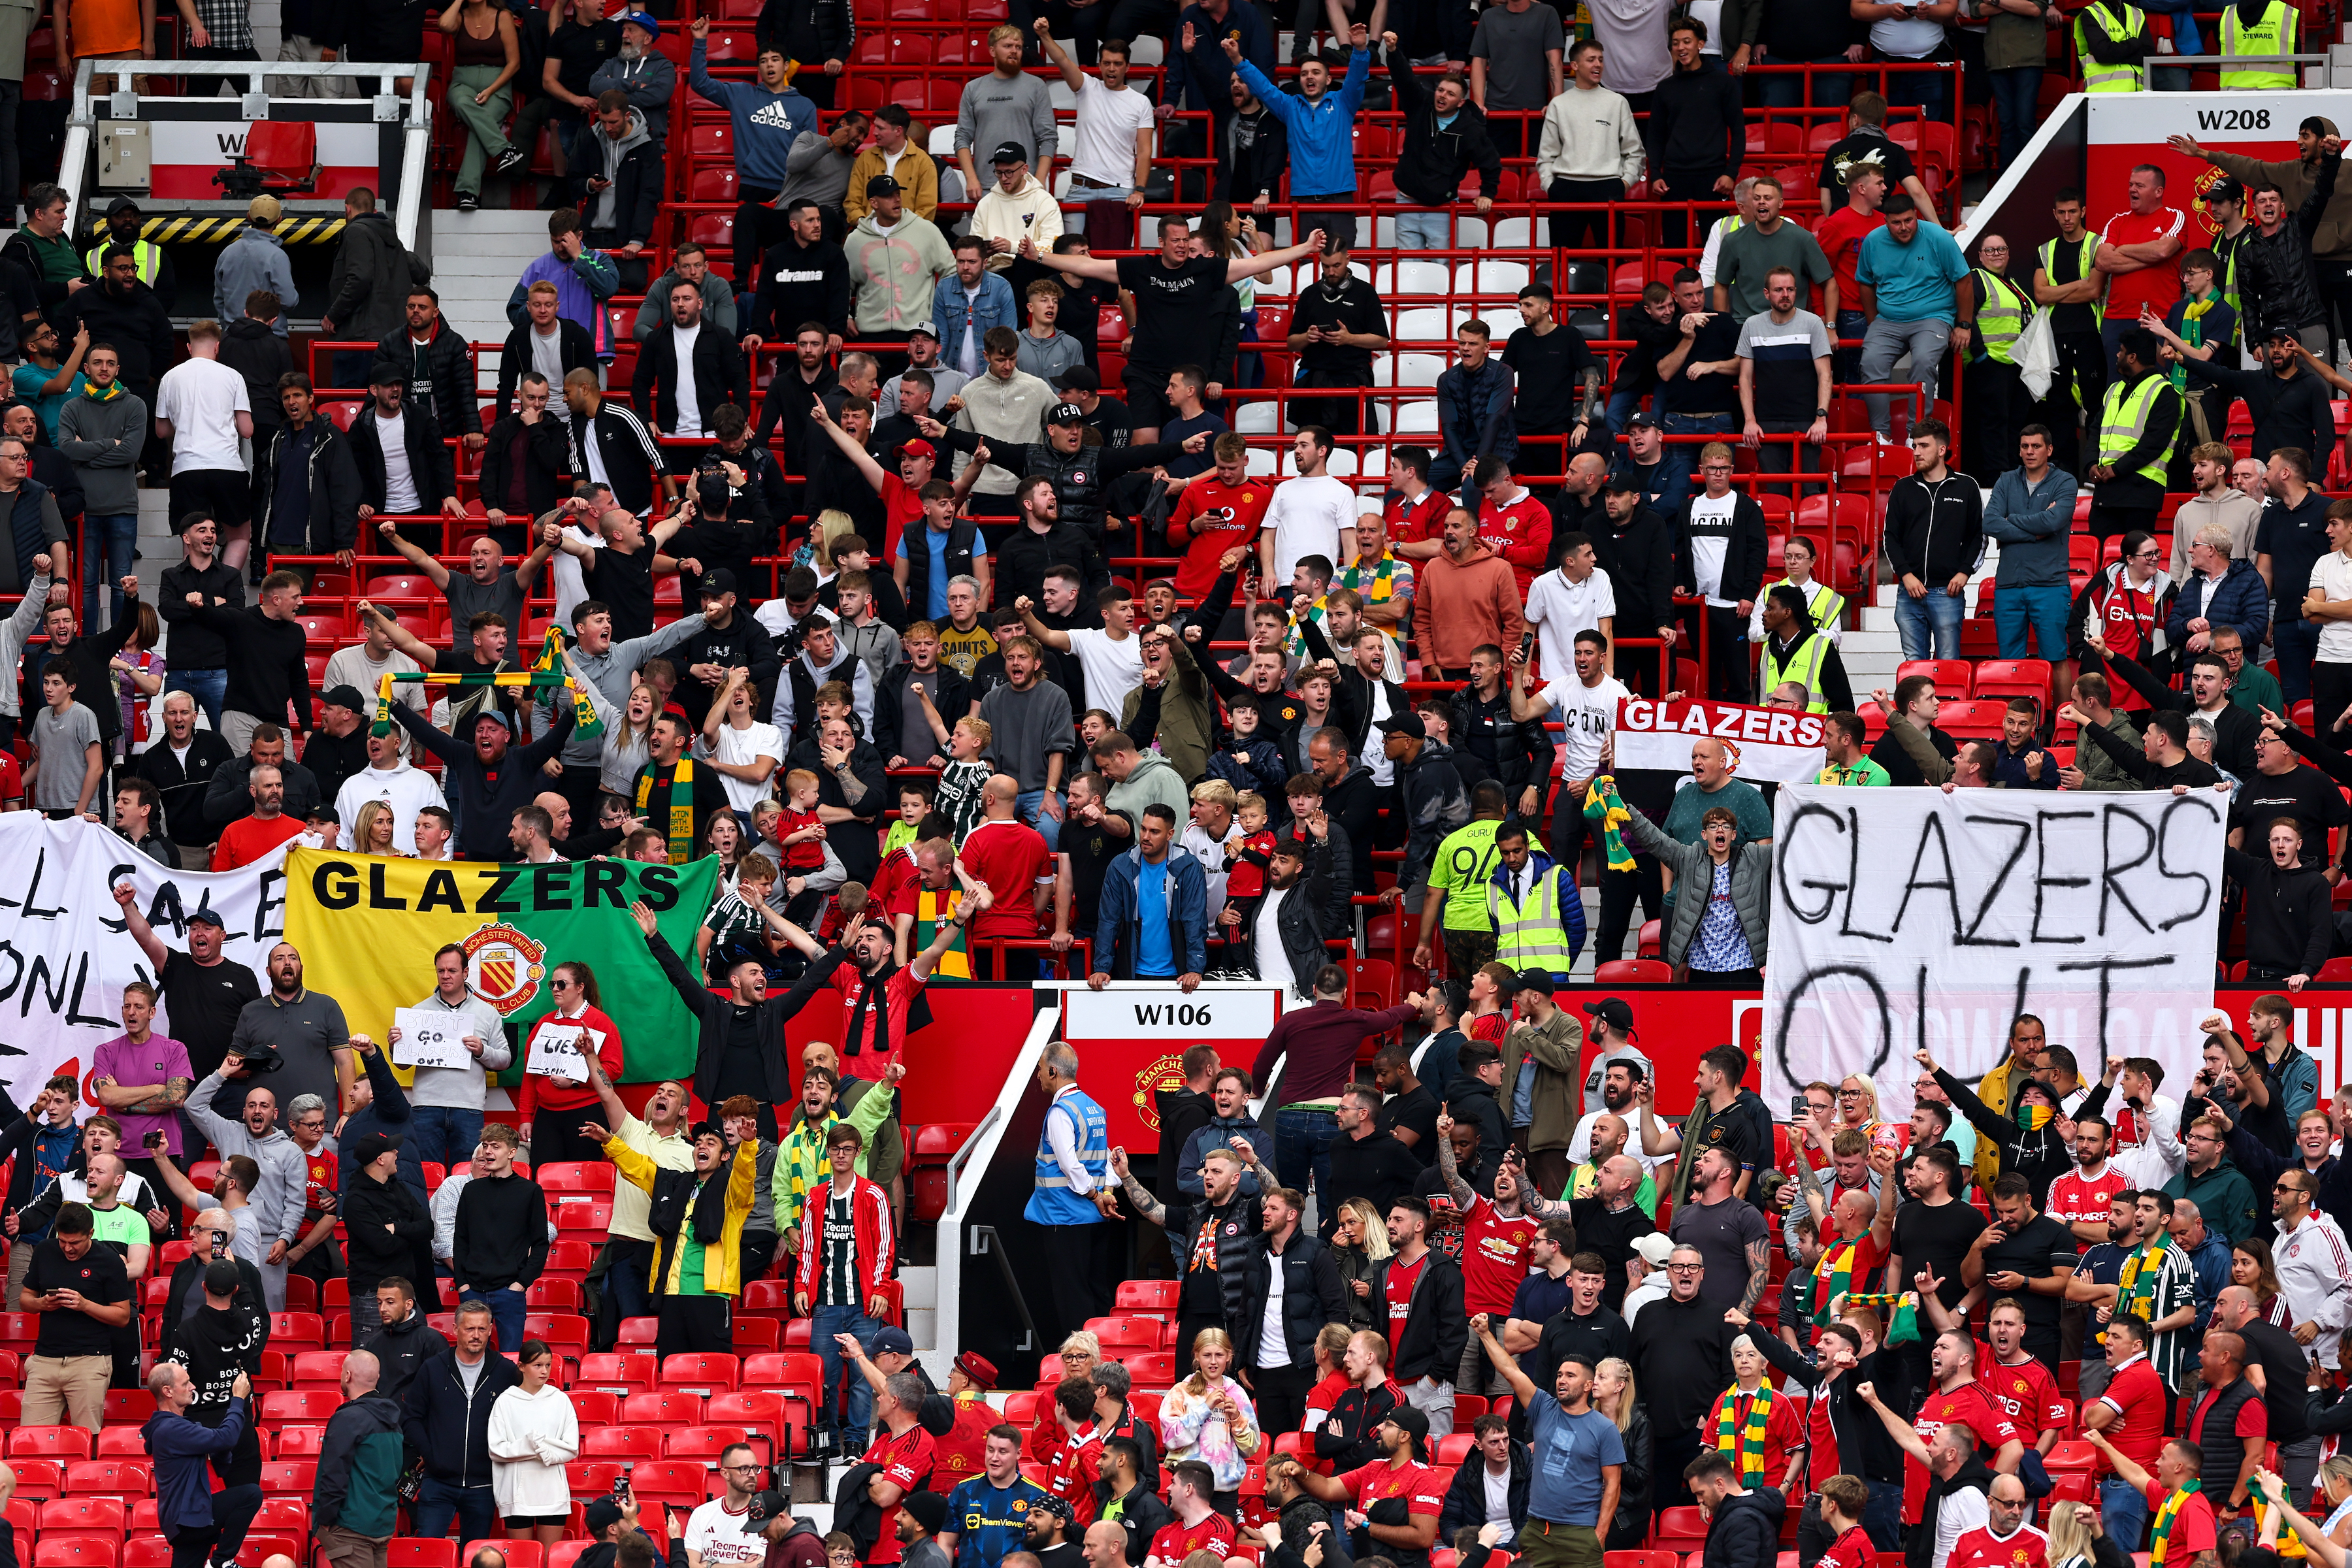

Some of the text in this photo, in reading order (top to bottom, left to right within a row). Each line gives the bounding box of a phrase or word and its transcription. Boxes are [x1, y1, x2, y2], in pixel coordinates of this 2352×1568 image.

[750, 117, 792, 130] adidas
[2198, 109, 2271, 130] W208
[776, 269, 823, 282] drama
[1150, 276, 1195, 290] BALMAIN
[1057, 404, 1082, 418] ICON
[1480, 535, 1513, 546] HARP
[941, 640, 988, 657] SAINTS
[1561, 706, 1605, 734] ICON
[1625, 700, 1823, 746] GLAZERS
[1467, 828, 1492, 838] GURU
[1452, 844, 1497, 892] 94
[1777, 796, 2220, 948] GLAZERS
[312, 861, 679, 913] GLAZERS
[99, 864, 286, 942] SALE
[465, 931, 536, 959] ANCHESTER UNITED
[509, 988, 531, 1007] CLUB
[1134, 1004, 1212, 1026] W106
[406, 1013, 465, 1032] JUST
[1776, 955, 2176, 1094] OUT
[540, 1024, 558, 1037] NO
[396, 1043, 468, 1060] GLAZERS
[417, 1057, 448, 1067] OUT.
[531, 1053, 589, 1072] NO MORE
[1141, 1060, 1184, 1086] MANCHE
[1086, 1117, 1098, 1126] DEPUTY
[2117, 1139, 2134, 1149] Team
[42, 1165, 62, 1179] Tezo
[2065, 1211, 2108, 1221] SHARP
[824, 1221, 851, 1233] Team
[823, 1229, 850, 1240] iewer
[1477, 1247, 1516, 1266] CHEVROLET
[1388, 1310, 1409, 1319] iewer
[220, 1367, 242, 1379] BOS
[206, 1380, 232, 1390] BOSS
[1917, 1418, 1933, 1428] Team
[1914, 1425, 1931, 1436] ewer
[819, 1431, 828, 1448] MM
[890, 1471, 911, 1482] TECHNOLOGY
[891, 1463, 915, 1480] DXC
[783, 1471, 790, 1487] LL
[980, 1517, 1025, 1528] TeamViewer
[711, 1540, 737, 1551] Team
[1207, 1537, 1230, 1555] DXC
[703, 1547, 736, 1559] Viewer
